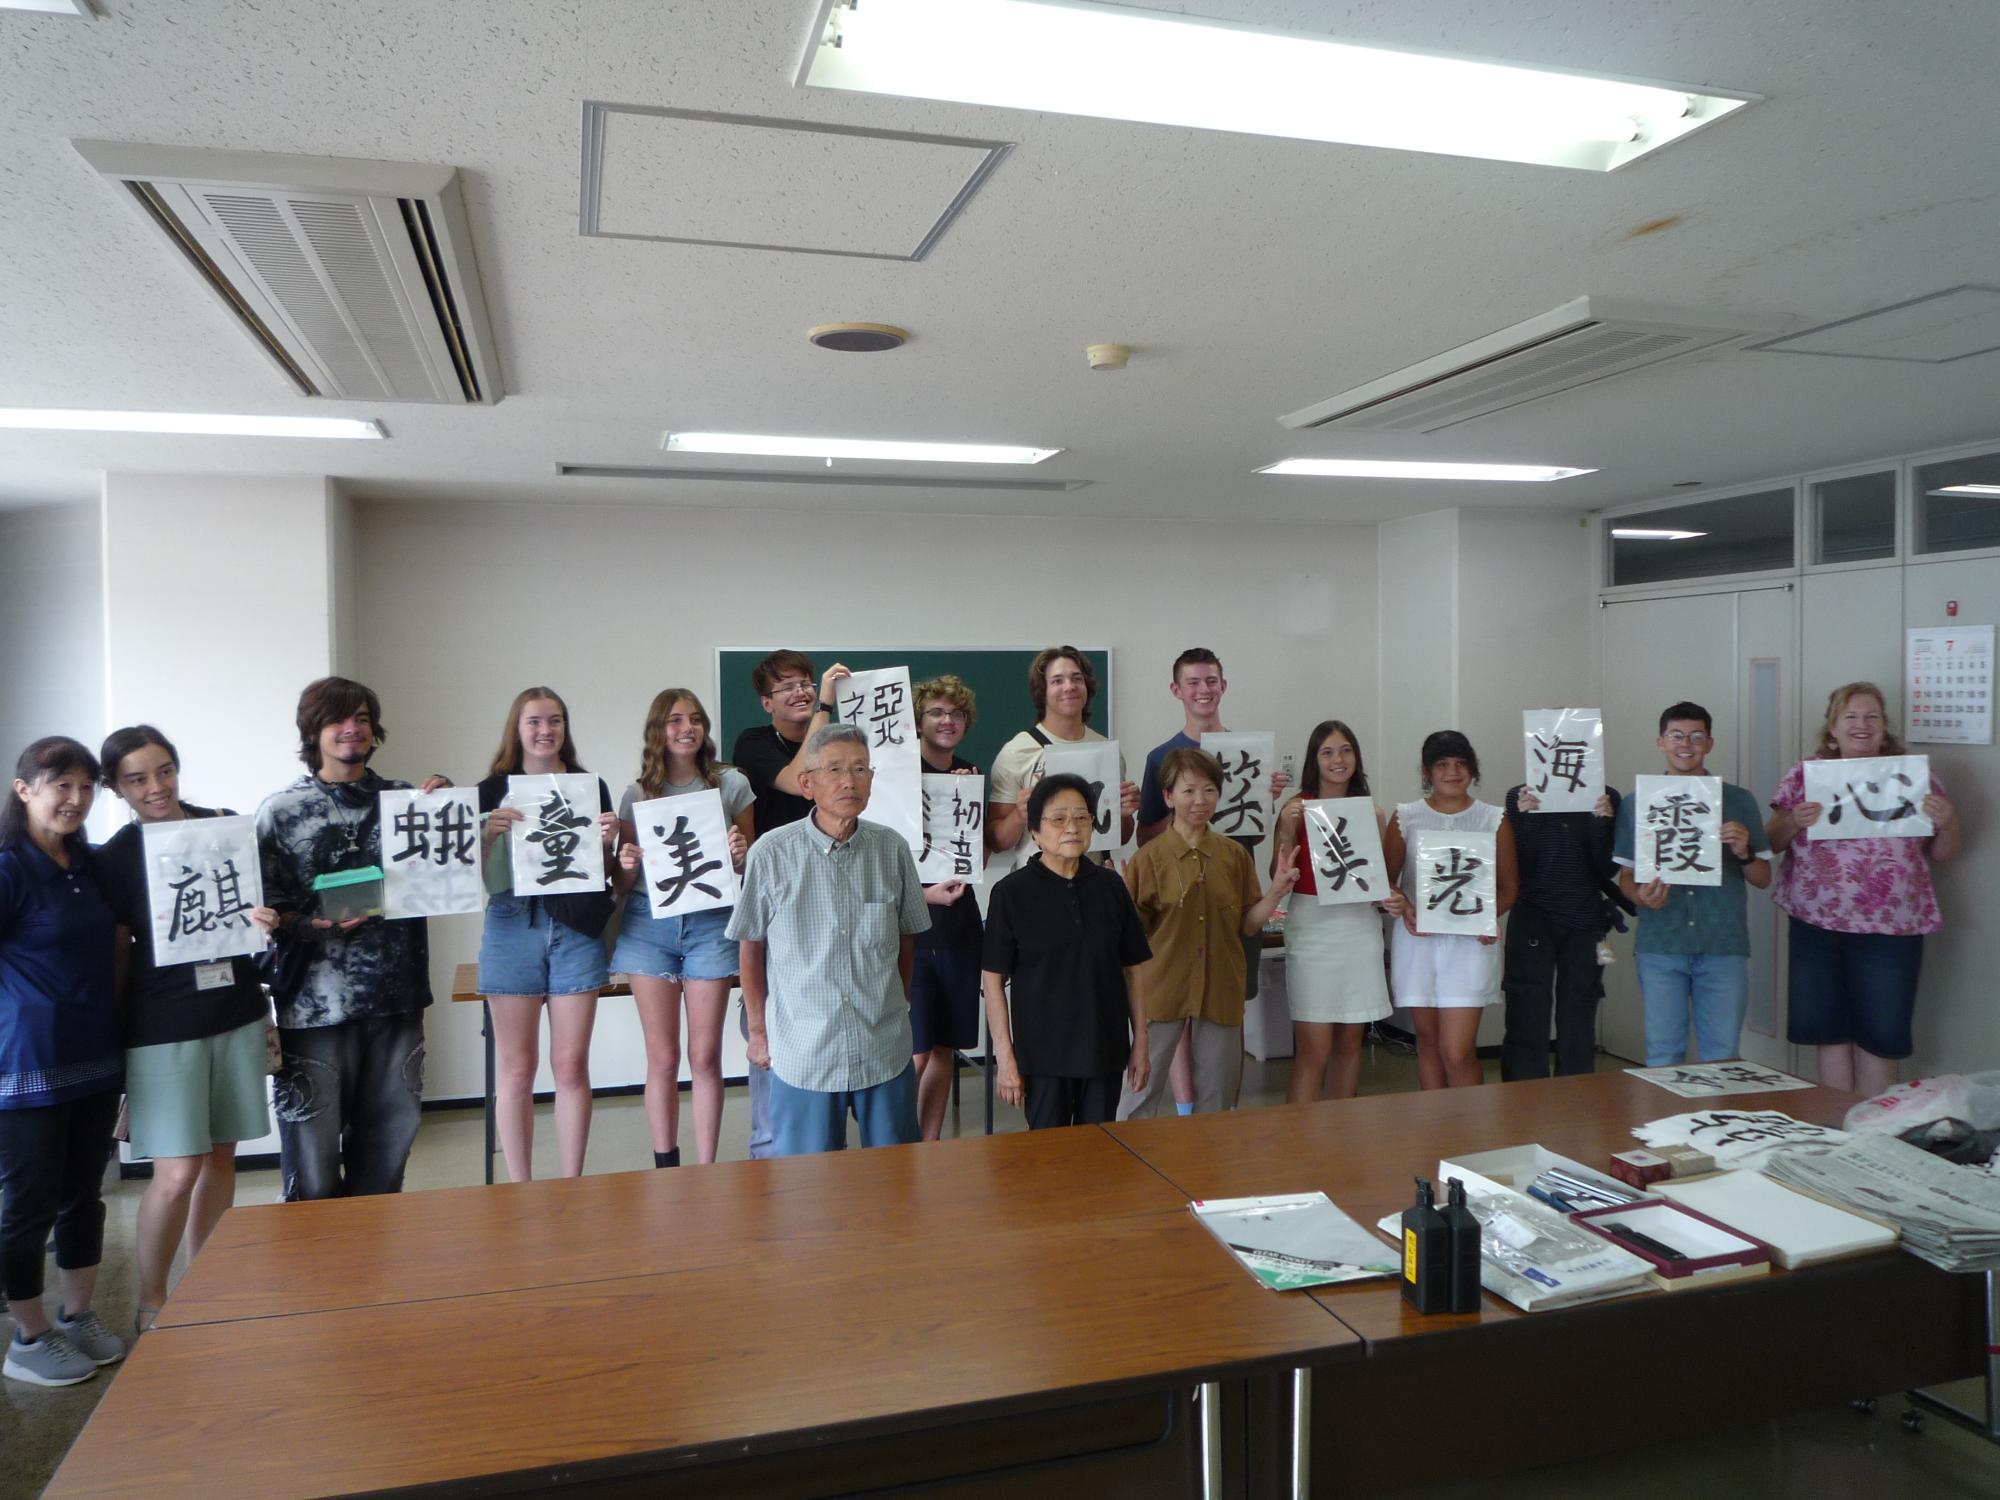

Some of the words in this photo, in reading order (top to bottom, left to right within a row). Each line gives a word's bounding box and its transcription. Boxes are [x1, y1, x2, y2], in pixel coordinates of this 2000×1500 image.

[1945, 639, 1955, 653] 7
[1533, 734, 1589, 794] 海
[1827, 772, 1918, 825] 心
[391, 800, 475, 866] 蛾
[524, 789, 593, 886] 童
[652, 815, 724, 908] 美
[949, 788, 982, 875] 初音
[1316, 815, 1369, 892] 美
[1647, 793, 1716, 873] 霞
[1427, 847, 1483, 916] 光
